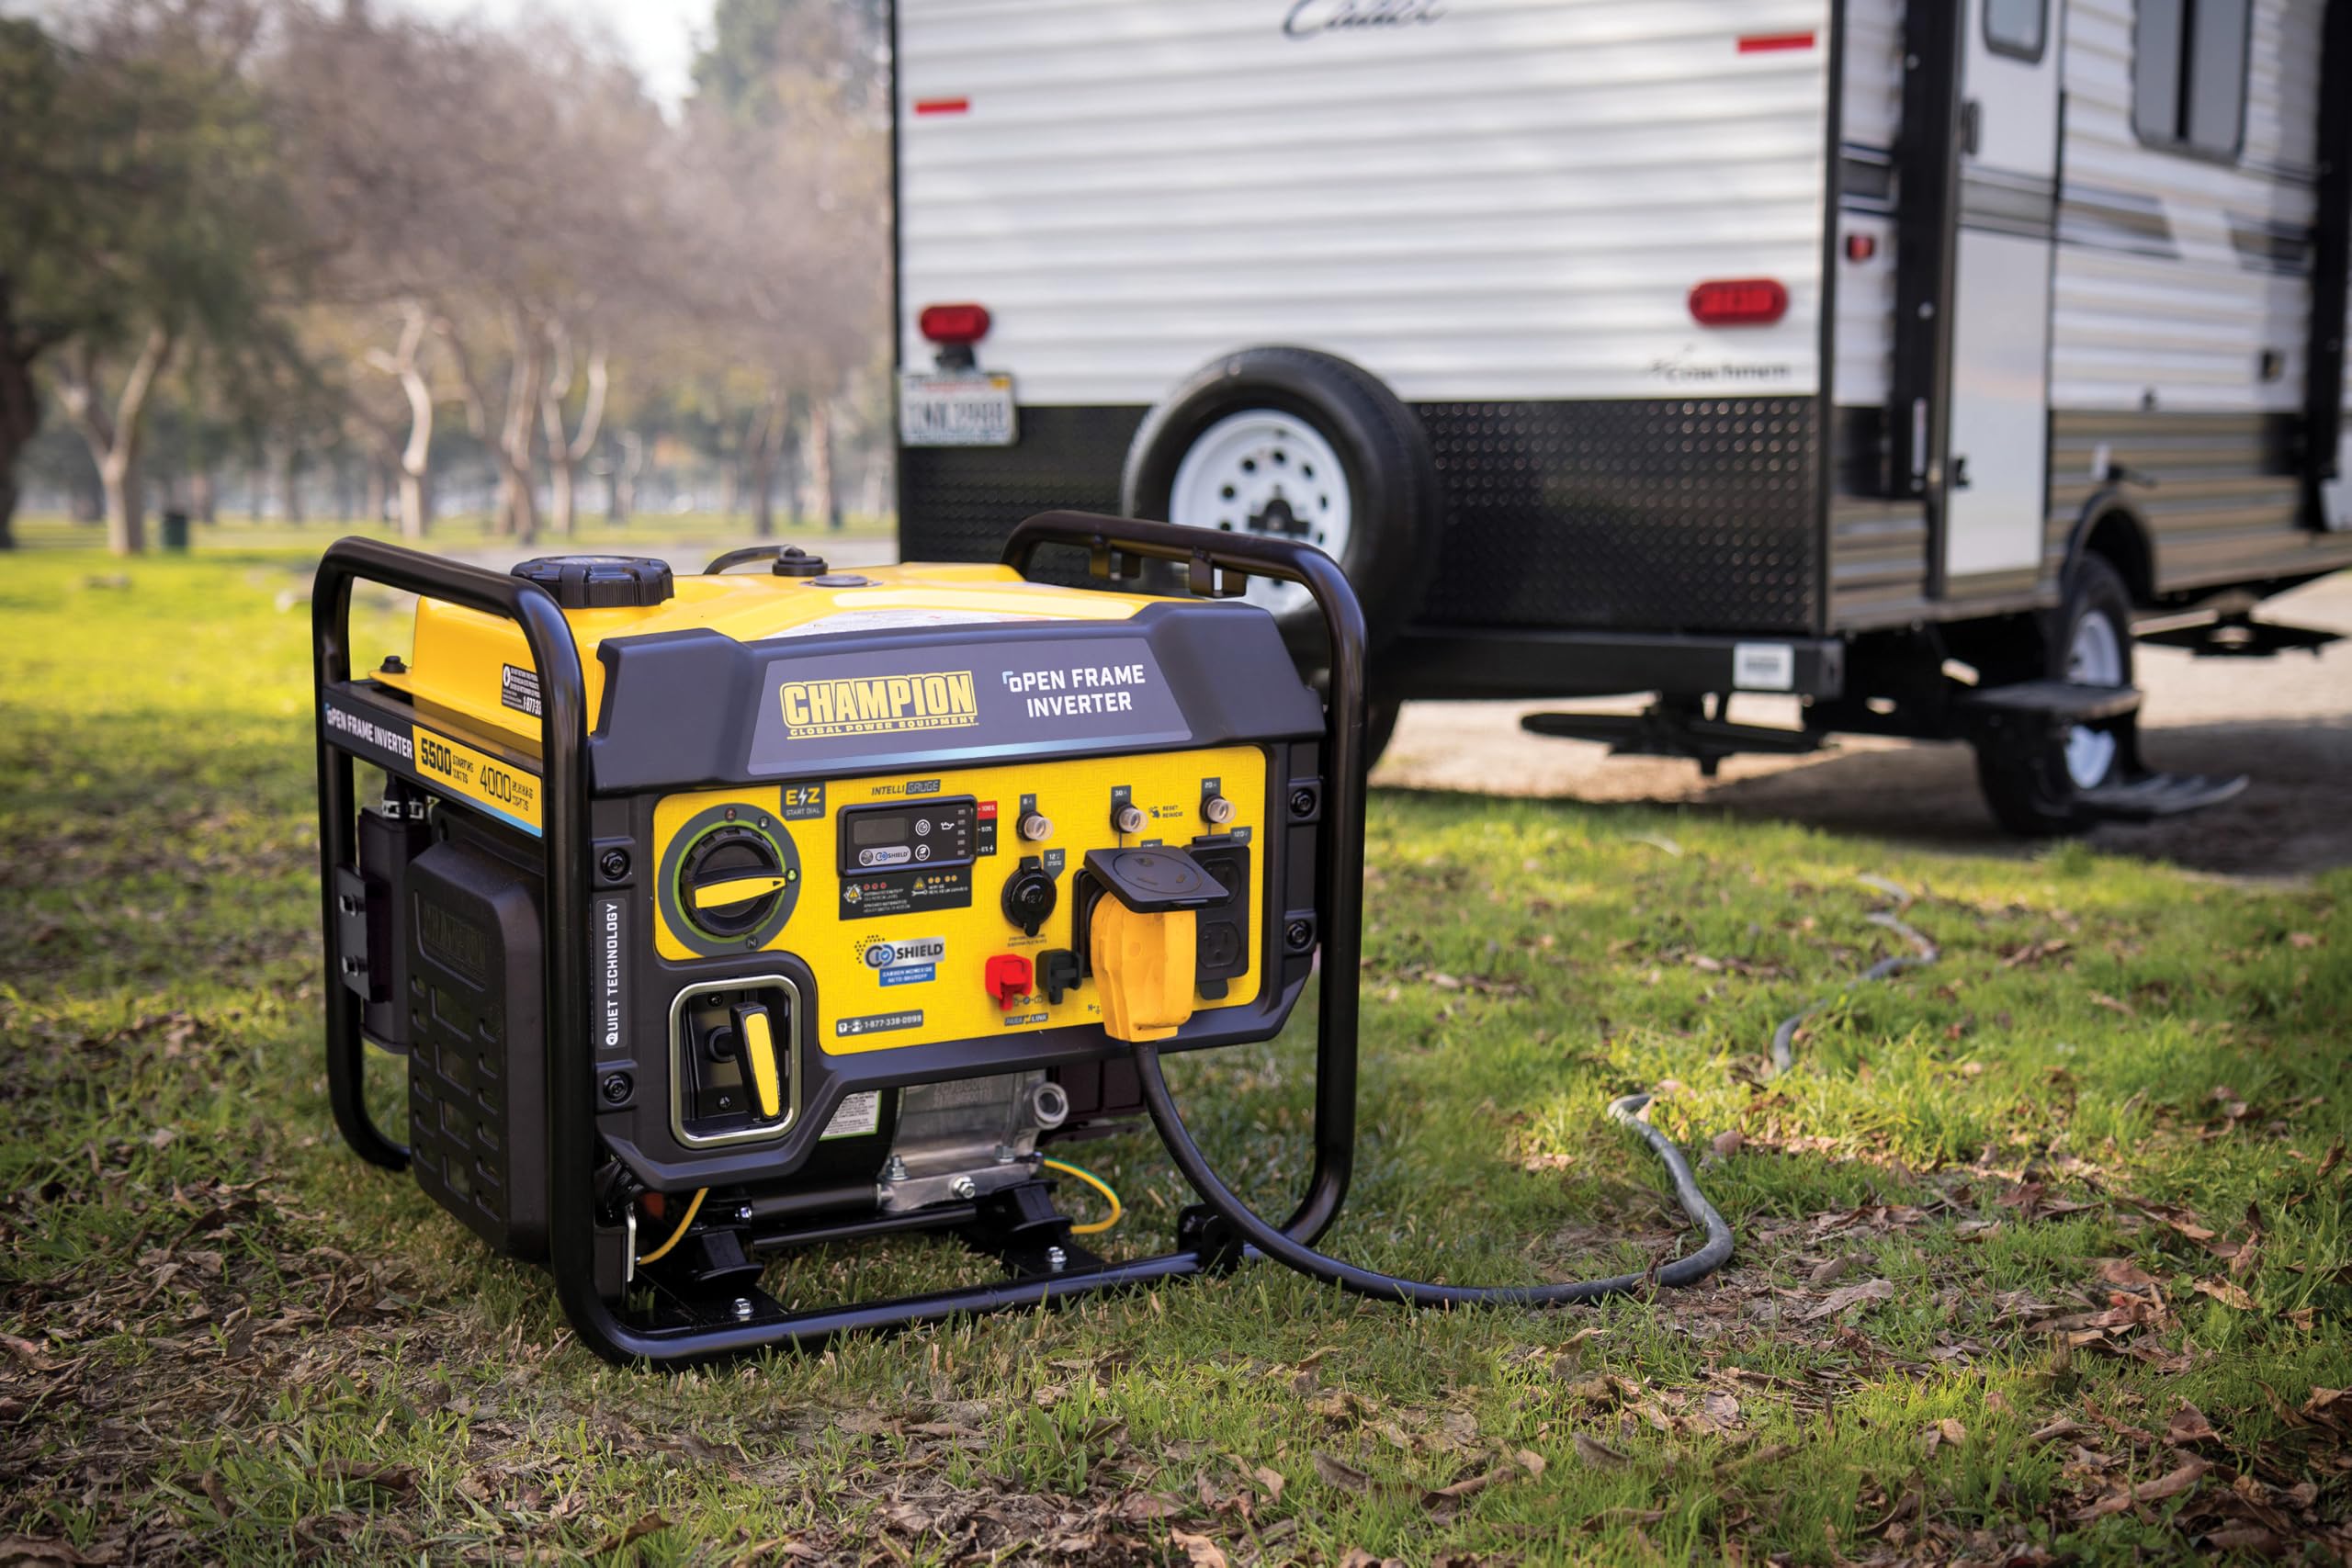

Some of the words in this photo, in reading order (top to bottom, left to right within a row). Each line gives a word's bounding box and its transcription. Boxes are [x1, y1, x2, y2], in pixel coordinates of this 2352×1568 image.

[1003, 670, 1066, 693] OPEN
[1071, 664, 1146, 687] FRAME
[782, 672, 977, 727] CHAMPION
[1026, 691, 1133, 717] INVERTER
[347, 714, 373, 742] FRAME
[374, 726, 413, 759] INVERTER
[790, 727, 842, 736] GLOBAL
[846, 722, 893, 732] POWER
[899, 716, 975, 728] EQUIPMENT
[421, 738, 451, 776] 5500
[480, 764, 511, 803] 4000
[786, 808, 804, 817] START
[606, 903, 618, 996] TECHNOLOGY
[896, 942, 943, 960] SHIELD
[605, 1000, 618, 1045] QUIET
